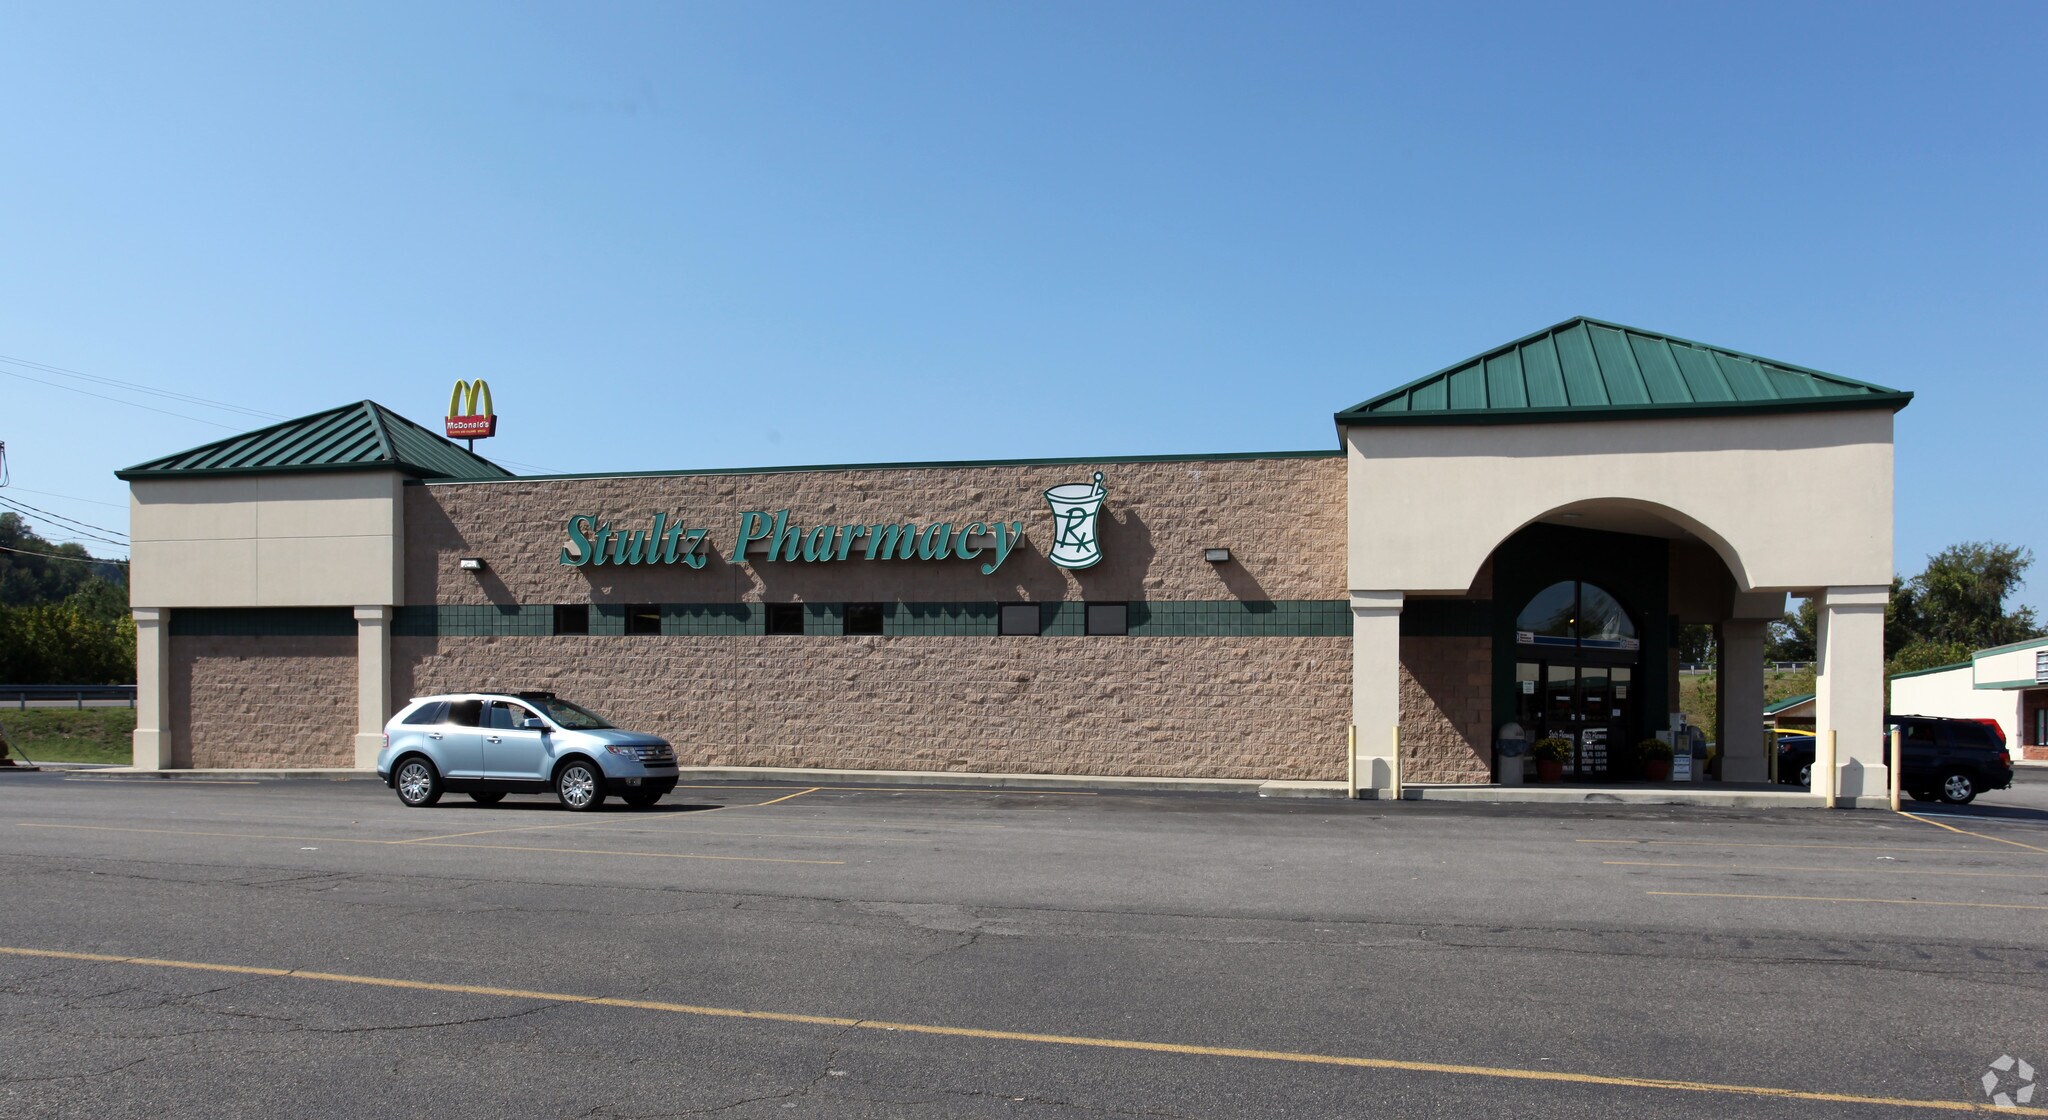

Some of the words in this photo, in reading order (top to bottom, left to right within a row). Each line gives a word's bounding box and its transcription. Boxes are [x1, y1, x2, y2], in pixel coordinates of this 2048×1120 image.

[447, 421, 490, 429] McDonald's
[560, 511, 711, 570] Stultz
[727, 508, 1024, 576] Pharmacy
